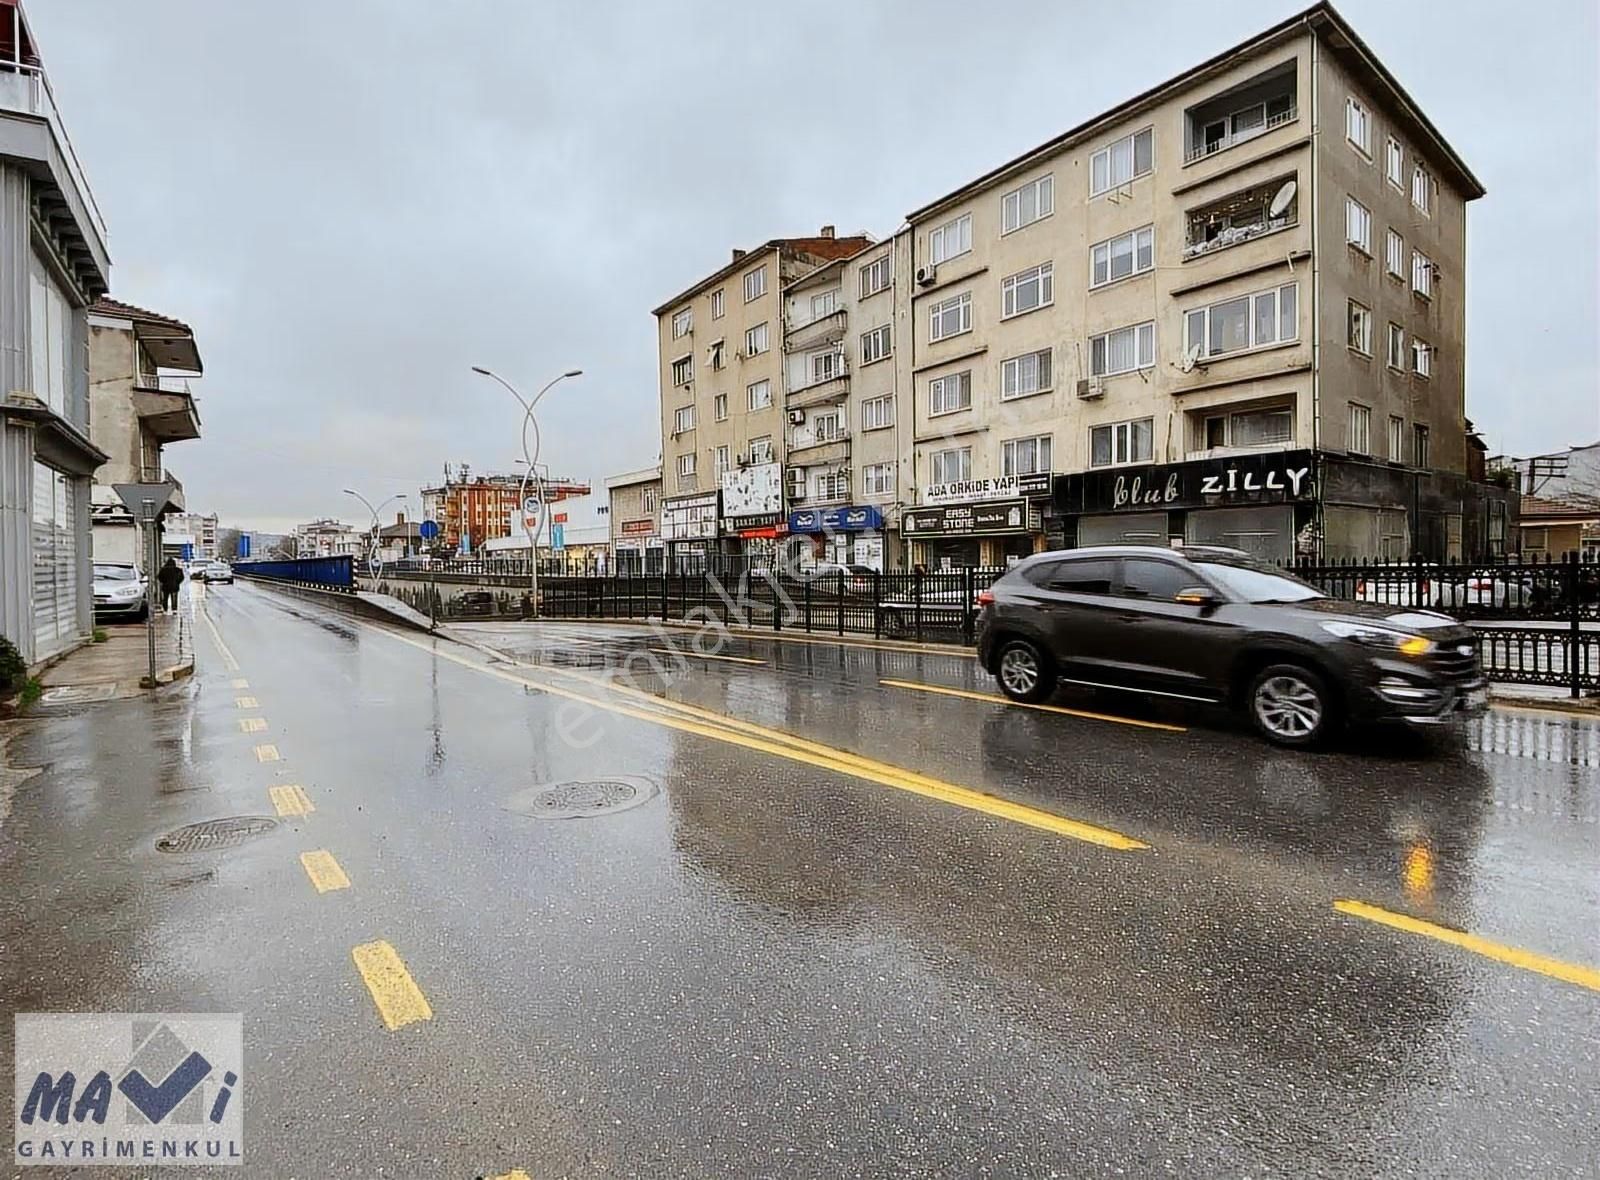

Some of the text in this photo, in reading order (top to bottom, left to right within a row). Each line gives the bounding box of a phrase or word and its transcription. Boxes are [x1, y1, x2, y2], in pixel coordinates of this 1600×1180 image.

[928, 484, 947, 497] ADA
[992, 476, 1019, 490] YAPI
[945, 508, 972, 519] EASY
